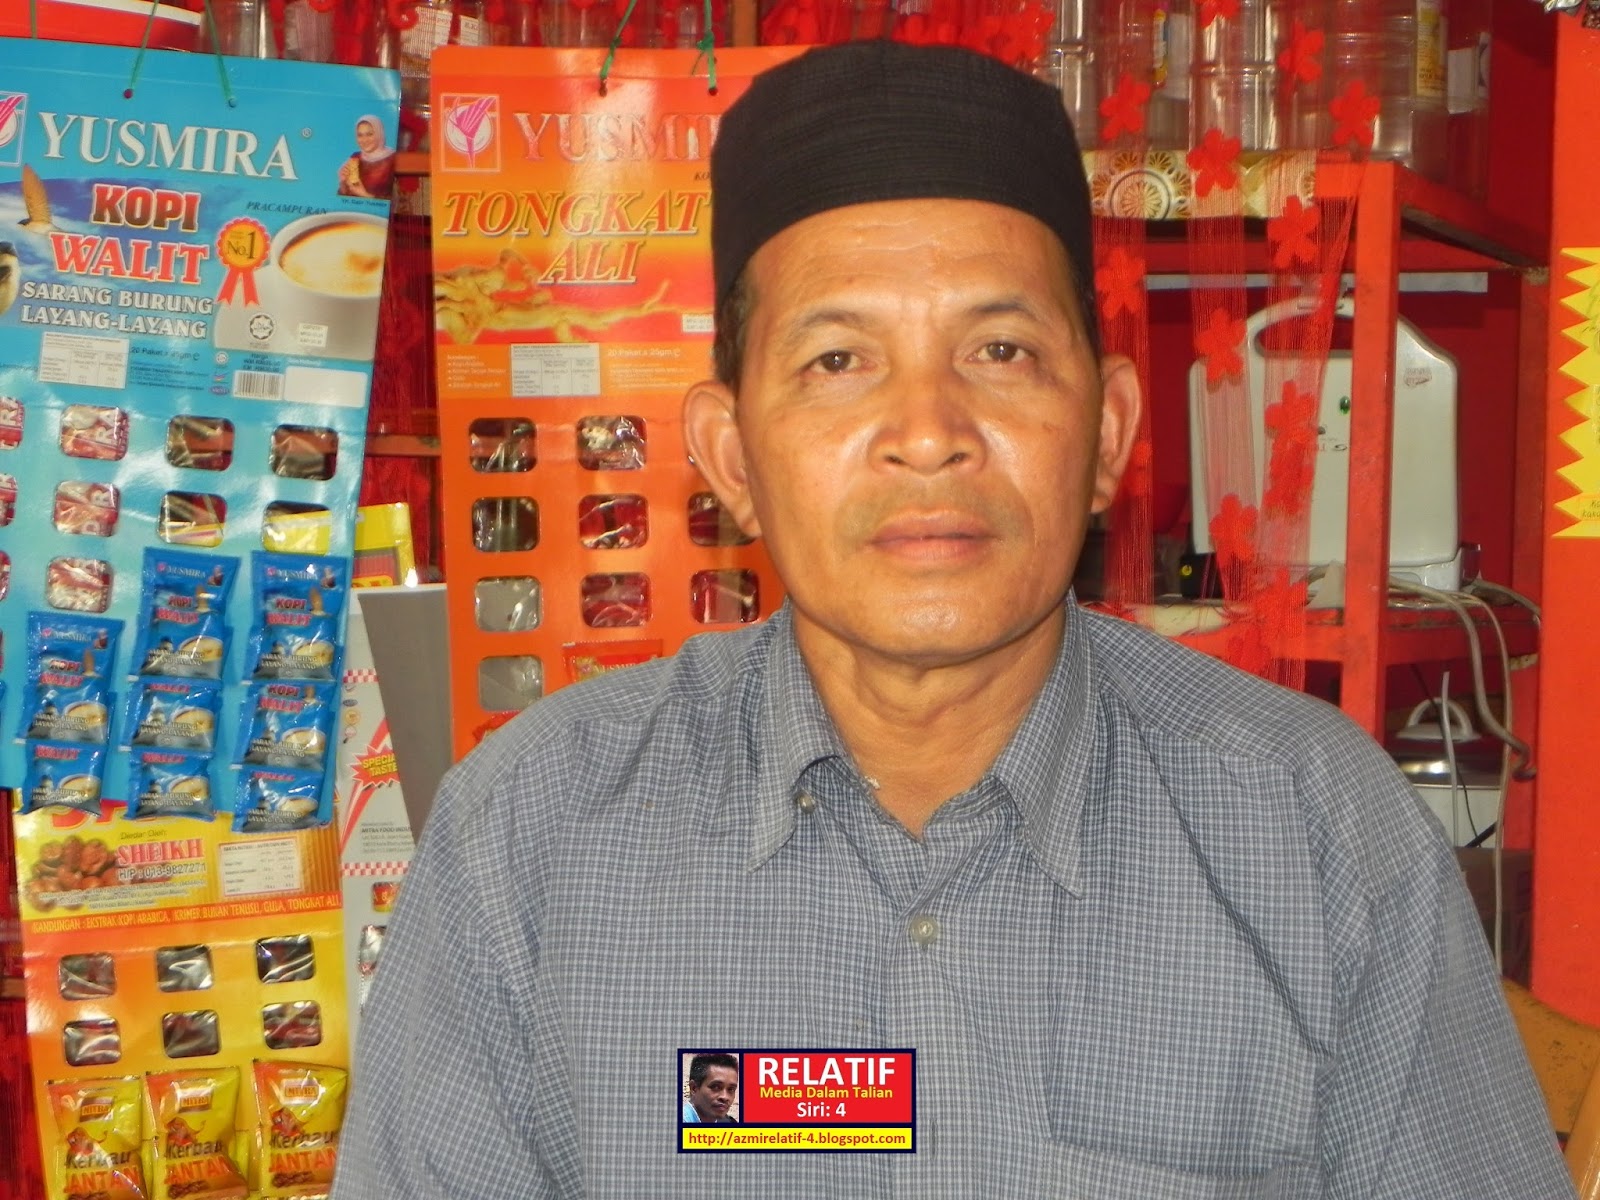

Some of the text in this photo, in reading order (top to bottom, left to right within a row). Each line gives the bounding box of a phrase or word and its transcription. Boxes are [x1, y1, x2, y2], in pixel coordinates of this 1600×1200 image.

[38, 111, 299, 181] YUSMIRA
[91, 183, 201, 232] KOPI
[442, 189, 711, 237] TONGKAT
[49, 232, 210, 285] WALIT
[537, 239, 647, 286] ALI
[21, 282, 214, 315] SARANG BURUNG
[20, 305, 208, 340] LAYANG-LAYANG
[275, 598, 307, 609] KOPI
[268, 684, 299, 696] KOPI
[370, 762, 398, 777] TASTE
[117, 838, 204, 866] SHEIKH
[118, 868, 136, 881] H/P
[32, 919, 81, 933] KANDUNGAN
[87, 916, 116, 929] EKSTRAK
[203, 906, 228, 918] BUKAN
[289, 896, 325, 910] TONGKAT
